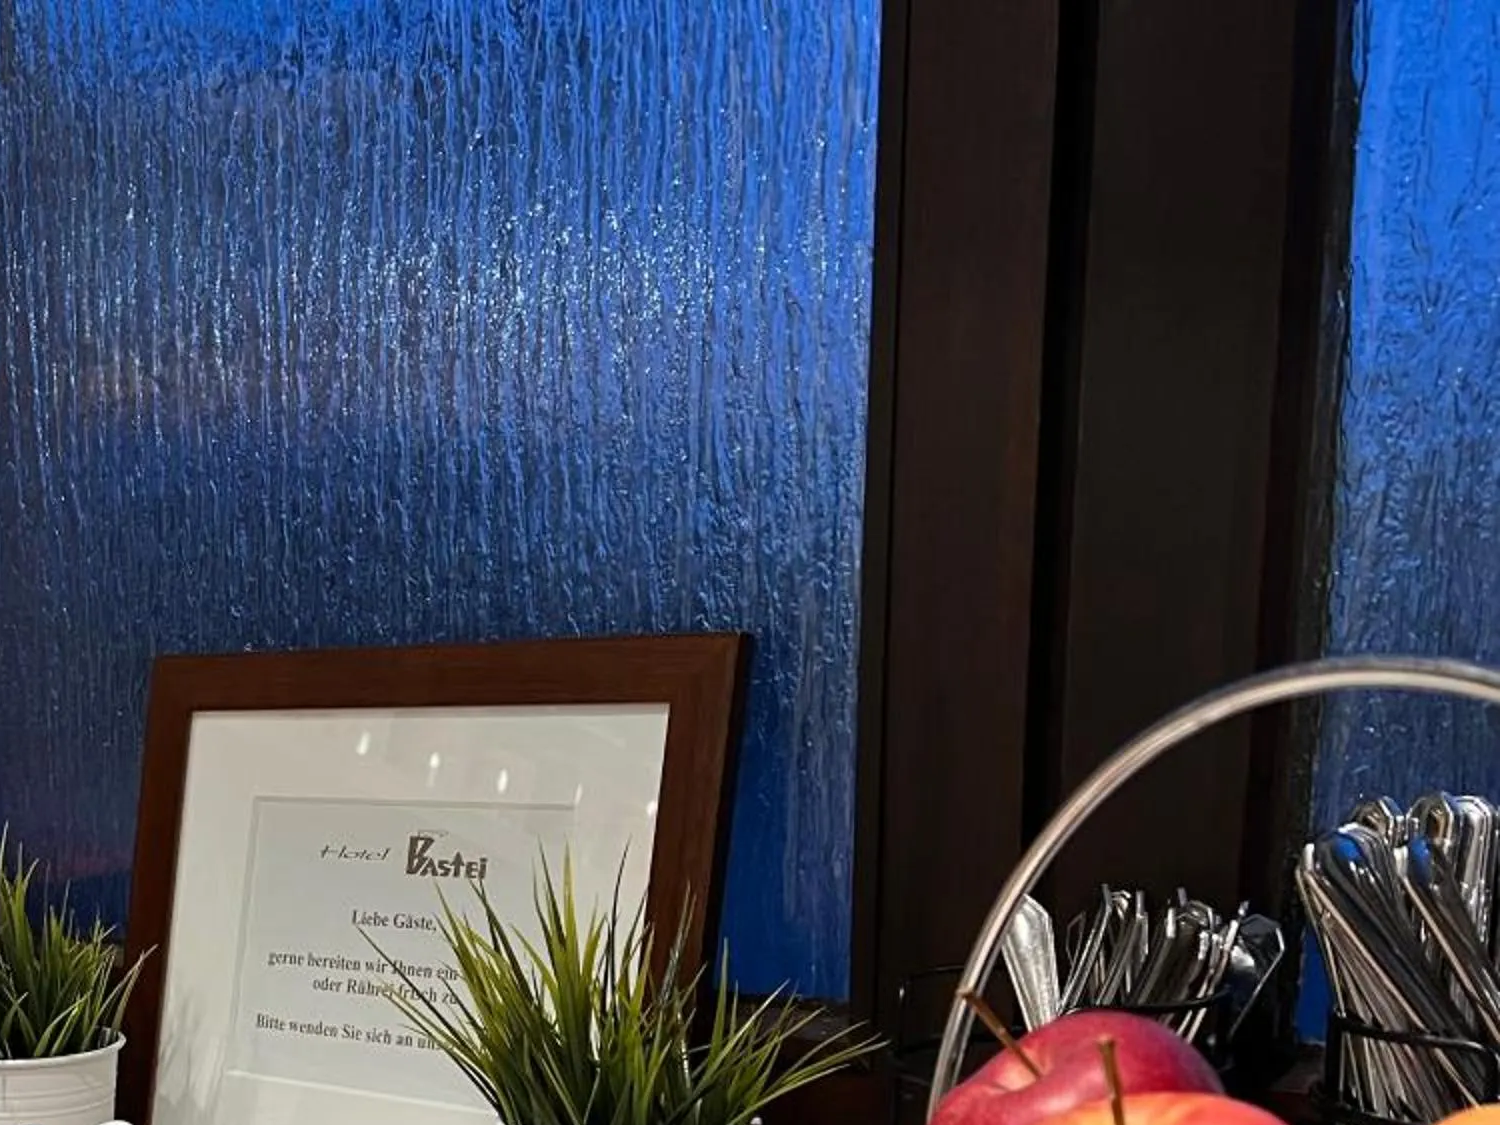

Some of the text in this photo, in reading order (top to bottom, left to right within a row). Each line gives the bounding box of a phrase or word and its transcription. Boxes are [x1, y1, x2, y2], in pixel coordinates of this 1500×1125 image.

[320, 845, 392, 861] Hotel
[352, 910, 437, 931] Liebe Gäste,
[268, 951, 304, 967] gerne
[307, 952, 360, 971] bereiten
[365, 959, 388, 974] wir
[392, 959, 432, 979] Ihnen
[312, 977, 342, 993] oder
[256, 1013, 286, 1031] Bitte
[289, 1022, 338, 1038] wenden
[342, 1024, 362, 1041] Sie
[366, 1026, 392, 1046] sich
[396, 1034, 413, 1047] an
